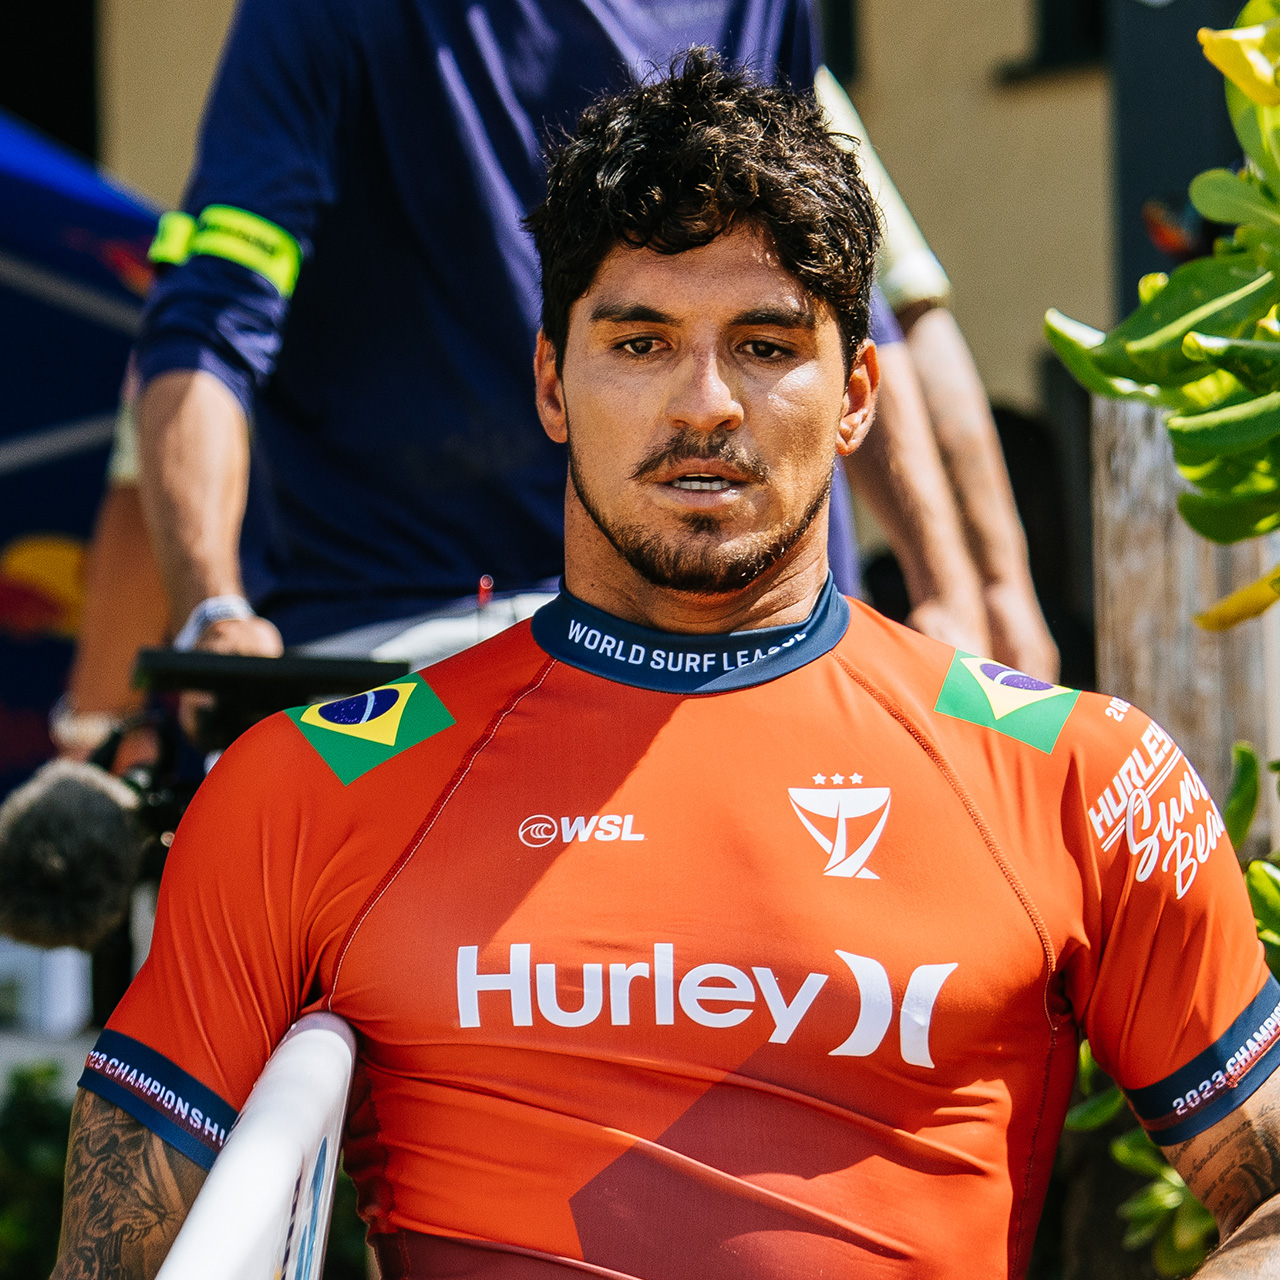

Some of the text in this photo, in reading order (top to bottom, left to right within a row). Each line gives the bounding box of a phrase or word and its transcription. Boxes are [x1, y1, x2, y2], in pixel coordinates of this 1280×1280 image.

[567, 619, 807, 673] WORLD SURF LEA
[1087, 719, 1176, 840] HURLEY
[560, 814, 646, 843] WSL
[1125, 756, 1210, 883] Sun
[456, 942, 829, 1045] Hurley
[1172, 1069, 1228, 1117] 2023
